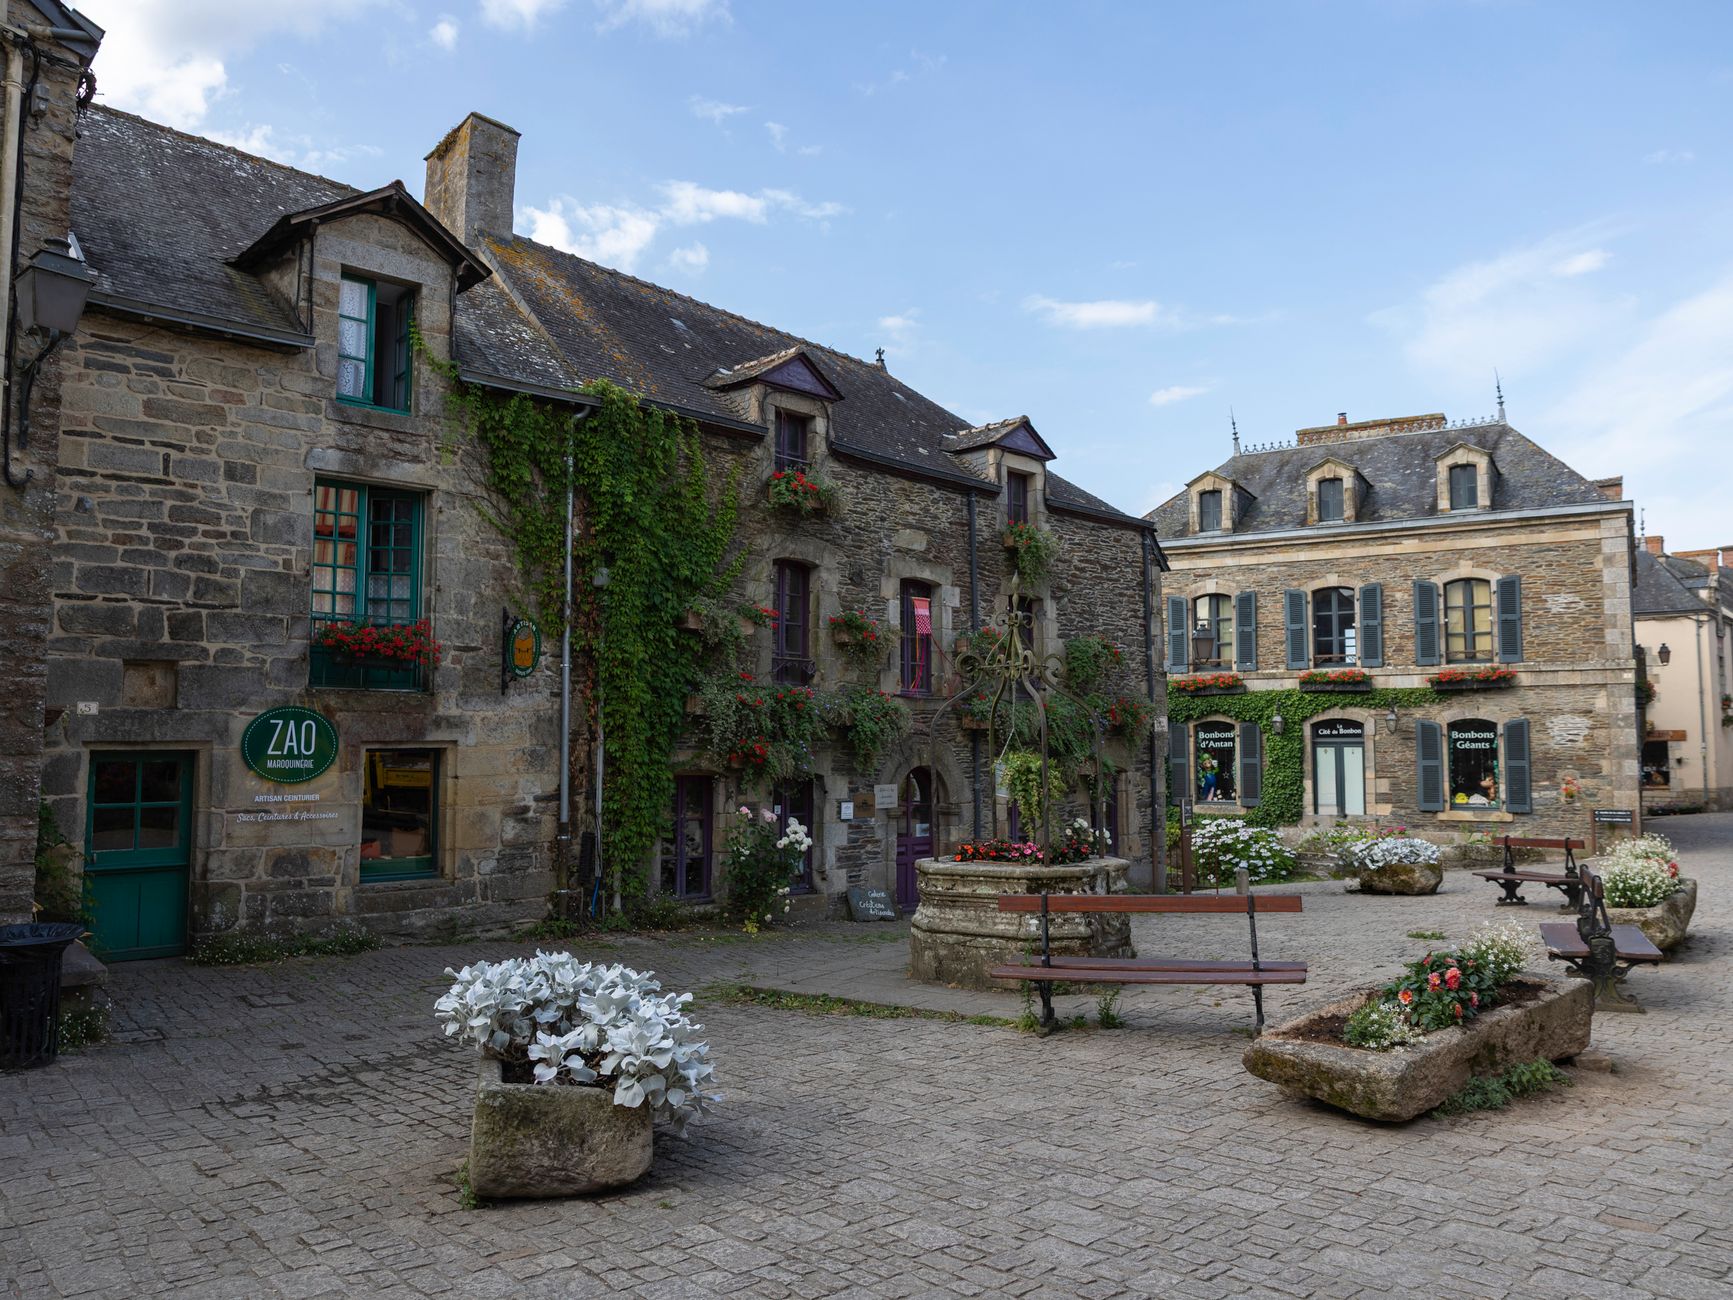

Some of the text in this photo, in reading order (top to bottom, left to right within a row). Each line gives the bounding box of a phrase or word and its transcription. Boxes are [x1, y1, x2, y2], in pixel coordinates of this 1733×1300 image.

[84, 704, 92, 713] 5
[1198, 730, 1235, 739] Bonbons
[1338, 727, 1362, 735] Bonbon
[1451, 730, 1495, 739] Bonbons
[266, 719, 317, 755] ZAO
[1200, 740, 1233, 749] d'Antan
[1456, 740, 1490, 749] Géants
[266, 759, 315, 769] MAROQUINERIE
[254, 793, 320, 803] ARTISAN CEINTURIER
[257, 811, 293, 822] Ceintures
[293, 811, 299, 820] &
[300, 810, 338, 821] Accessoires
